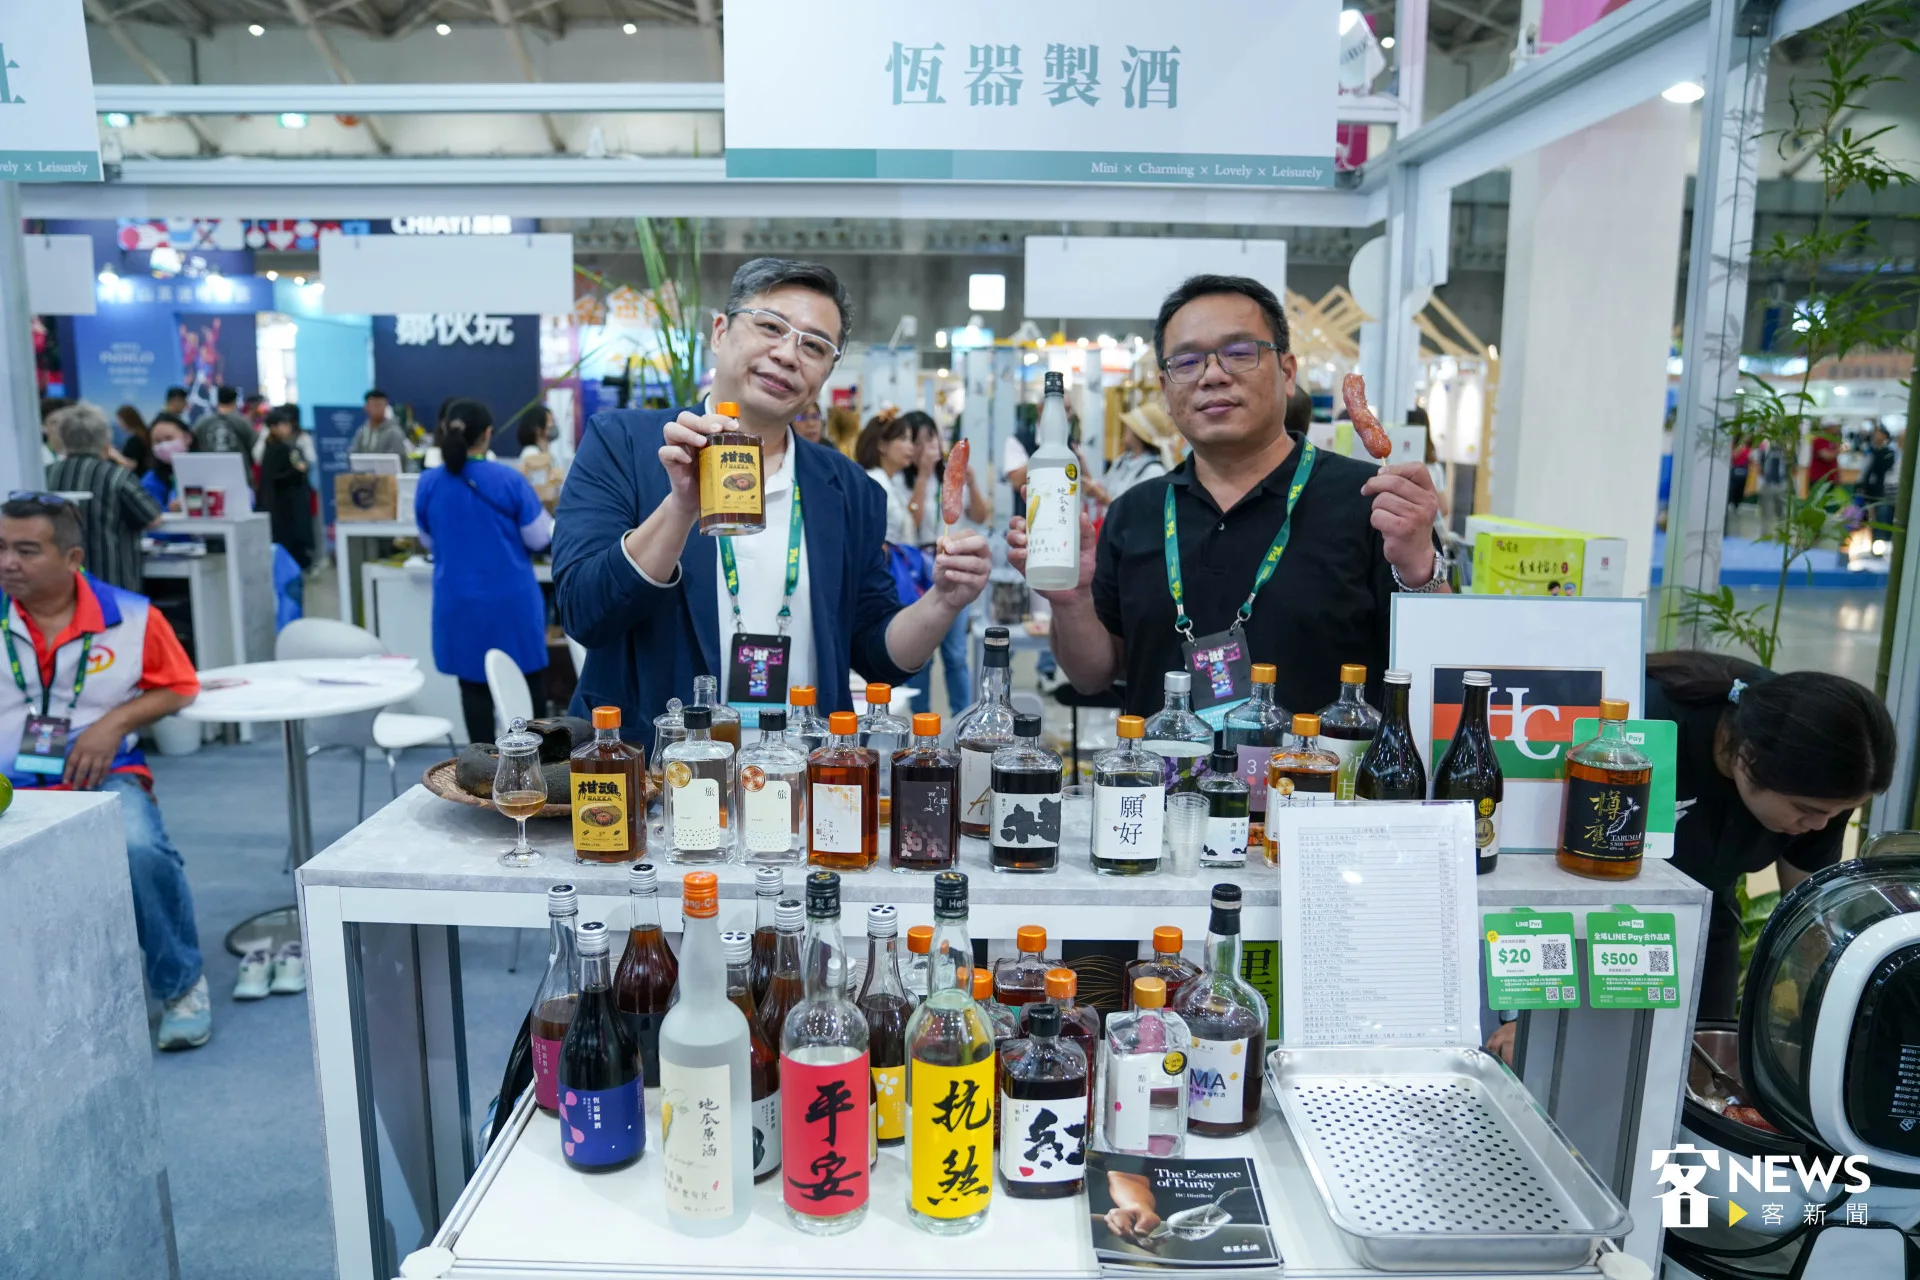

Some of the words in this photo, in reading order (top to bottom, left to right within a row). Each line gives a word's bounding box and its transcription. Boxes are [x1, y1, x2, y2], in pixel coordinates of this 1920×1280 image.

[884, 41, 1182, 109] 恆器製酒
[38, 161, 88, 175] Leisurely
[1091, 162, 1118, 174] Mini
[1138, 163, 1194, 177] Charming
[1215, 164, 1252, 179] Lovely
[1272, 165, 1323, 180] Leisurely
[1628, 734, 1643, 744] Pay
[1115, 795, 1145, 846] 願好
[1628, 934, 1643, 942] Pay
[1498, 948, 1531, 964] $20
[1601, 952, 1638, 966] $500
[698, 1097, 720, 1157] 地瓜原酒
[788, 1080, 862, 1201] 平安
[1155, 1168, 1183, 1179] The
[1186, 1170, 1241, 1179] Essence
[1157, 1179, 1172, 1187] of
[1175, 1179, 1216, 1191] Purity
